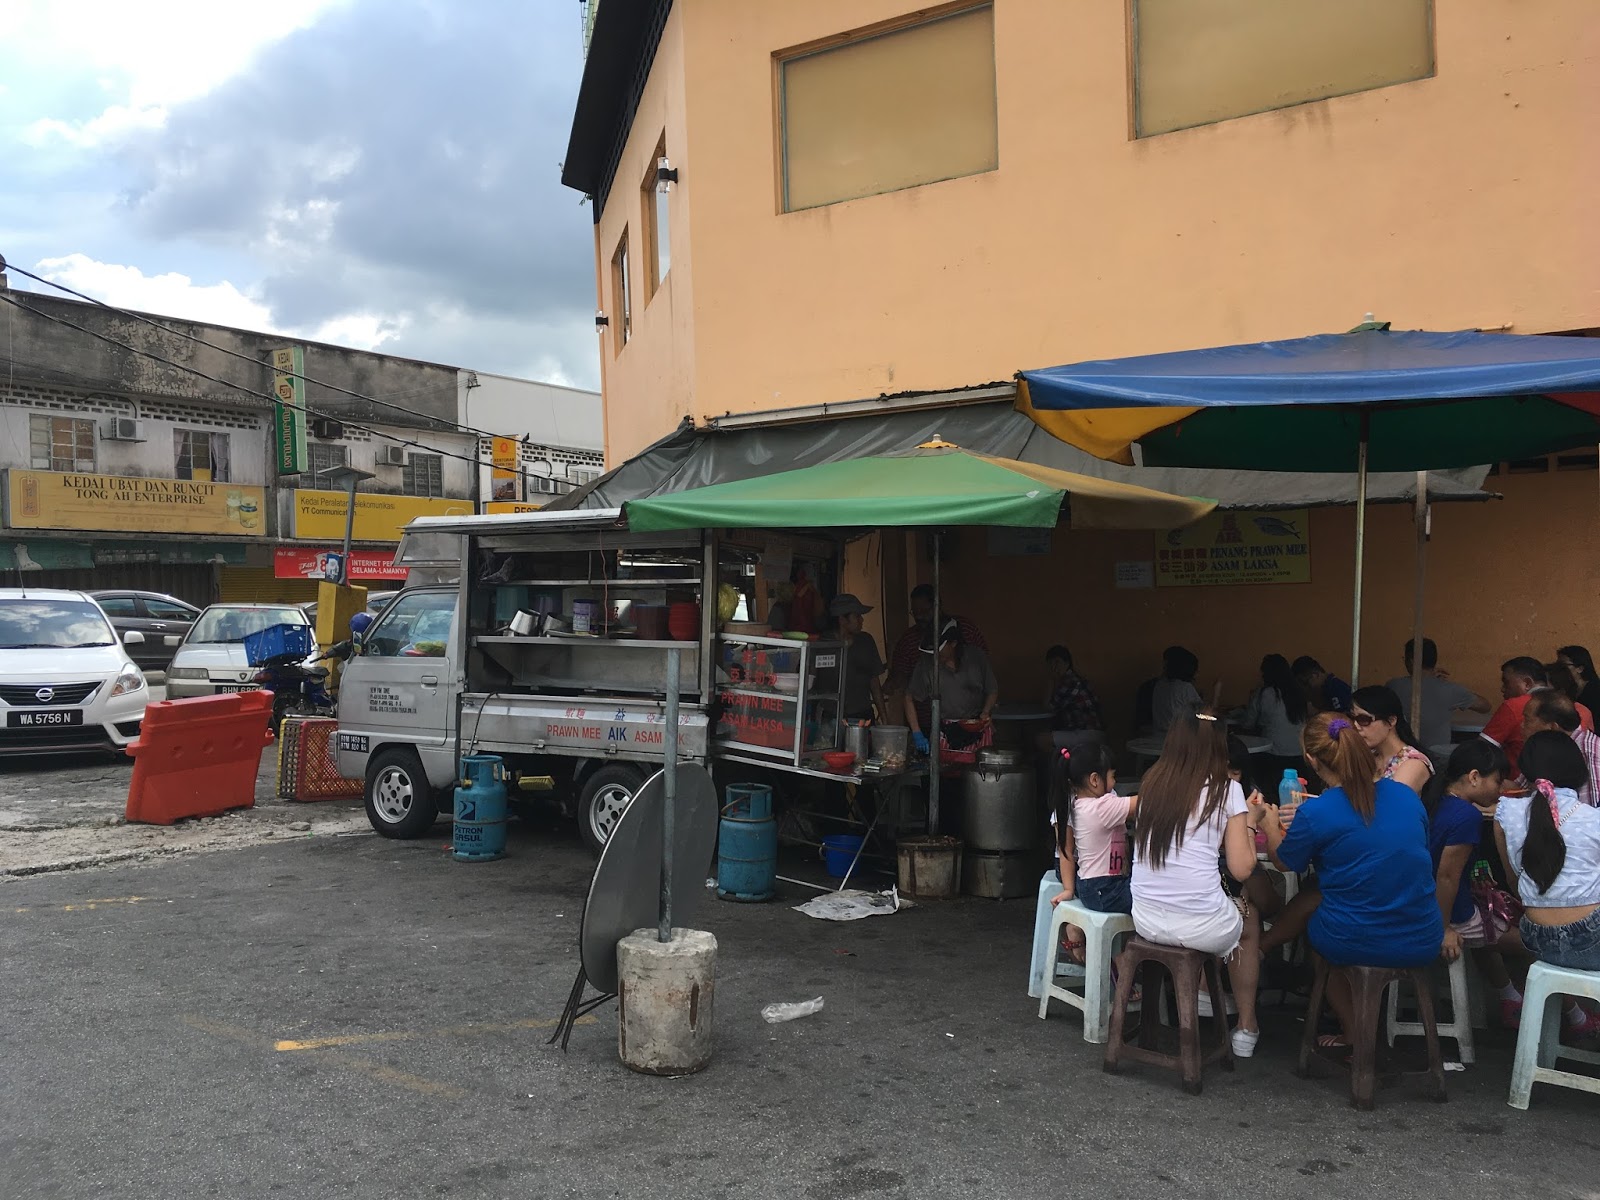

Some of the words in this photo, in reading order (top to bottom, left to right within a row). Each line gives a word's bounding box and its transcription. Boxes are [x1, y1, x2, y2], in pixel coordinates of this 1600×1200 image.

[278, 352, 290, 364] KEDAI
[63, 476, 105, 489] KEDAI
[109, 478, 140, 490] UBAT
[145, 480, 169, 492] DAN
[173, 483, 216, 496] RUNCIT
[75, 488, 108, 500] TONG
[113, 490, 132, 501] AH
[135, 492, 206, 504] ENTERPRISE
[300, 496, 320, 506] Kedai
[353, 500, 396, 510] elekomunikasi
[300, 506, 310, 514] YT
[311, 507, 356, 516] Communicatn
[1210, 546, 1248, 558] PENANG
[1250, 545, 1283, 557] PRAWN
[1286, 544, 1307, 556] MEE
[352, 567, 407, 575] SELAMA-LAMANYA
[1211, 560, 1239, 571] ASAM
[1244, 559, 1278, 570] LAKSA
[721, 692, 758, 708] PRAWN
[760, 698, 784, 712] MEE
[20, 714, 33, 724] WA
[35, 713, 61, 724] 5756
[64, 712, 71, 723] N
[720, 712, 748, 728] ASAM
[750, 716, 784, 733] LAKSA
[547, 724, 579, 738] PRAWN
[582, 726, 601, 740] MEE
[608, 726, 627, 742] AIK
[634, 730, 662, 744] ASAM
[455, 825, 483, 834] PETRON
